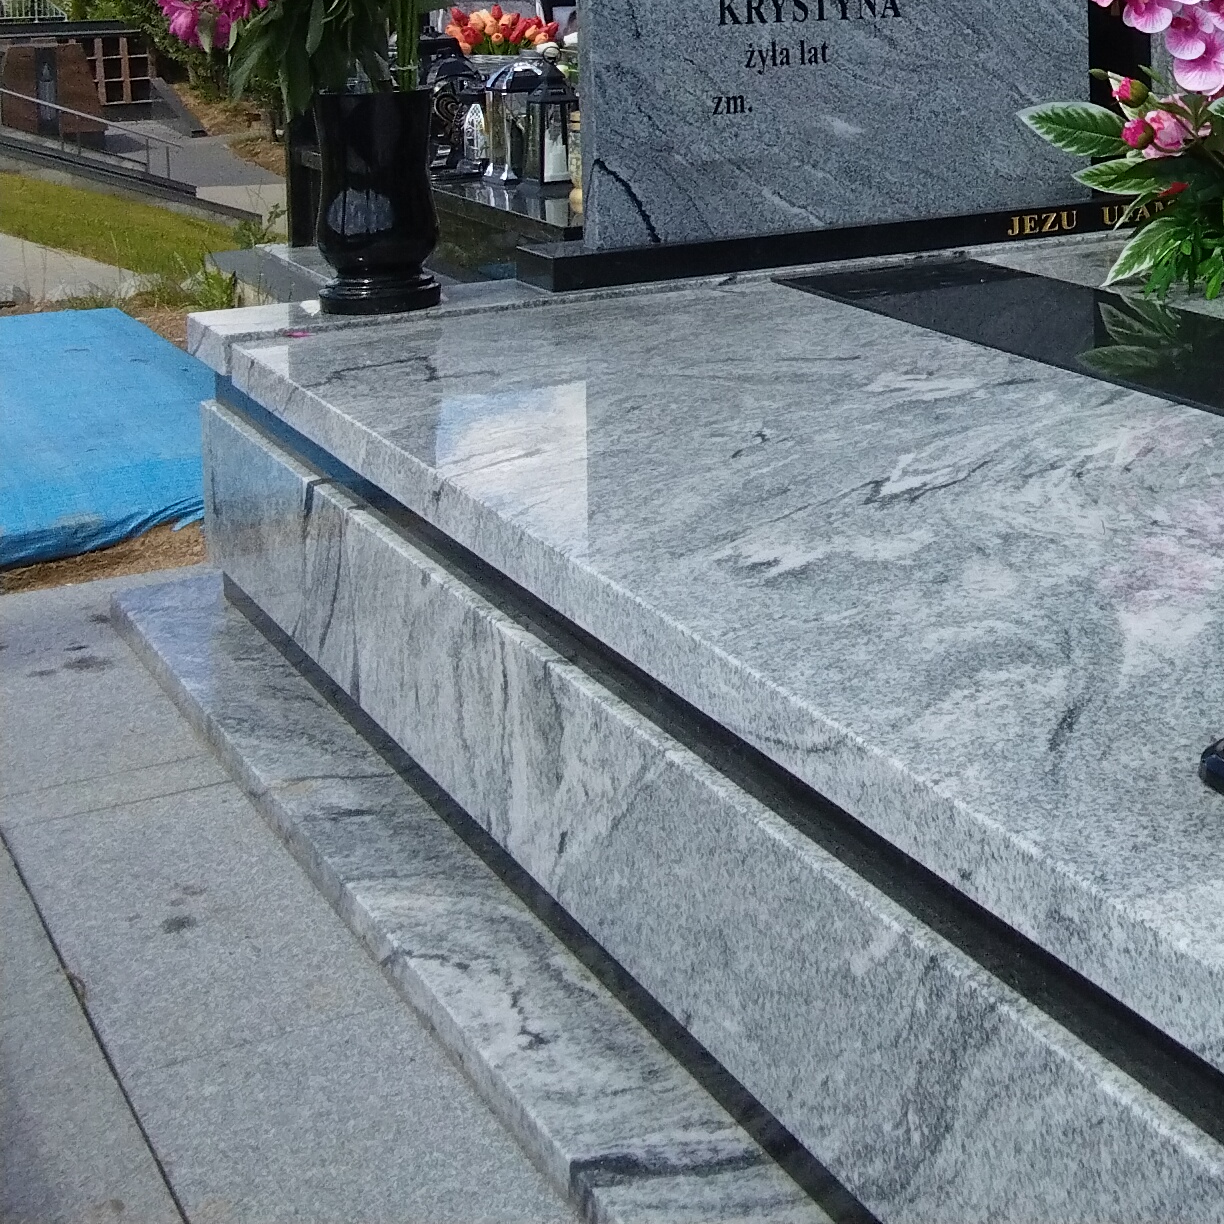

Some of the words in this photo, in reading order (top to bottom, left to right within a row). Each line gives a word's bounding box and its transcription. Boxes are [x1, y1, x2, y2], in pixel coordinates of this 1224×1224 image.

[744, 40, 791, 74] żyła
[799, 40, 829, 66] lat
[711, 94, 753, 116] zm.
[1007, 210, 1078, 237] JEZU
